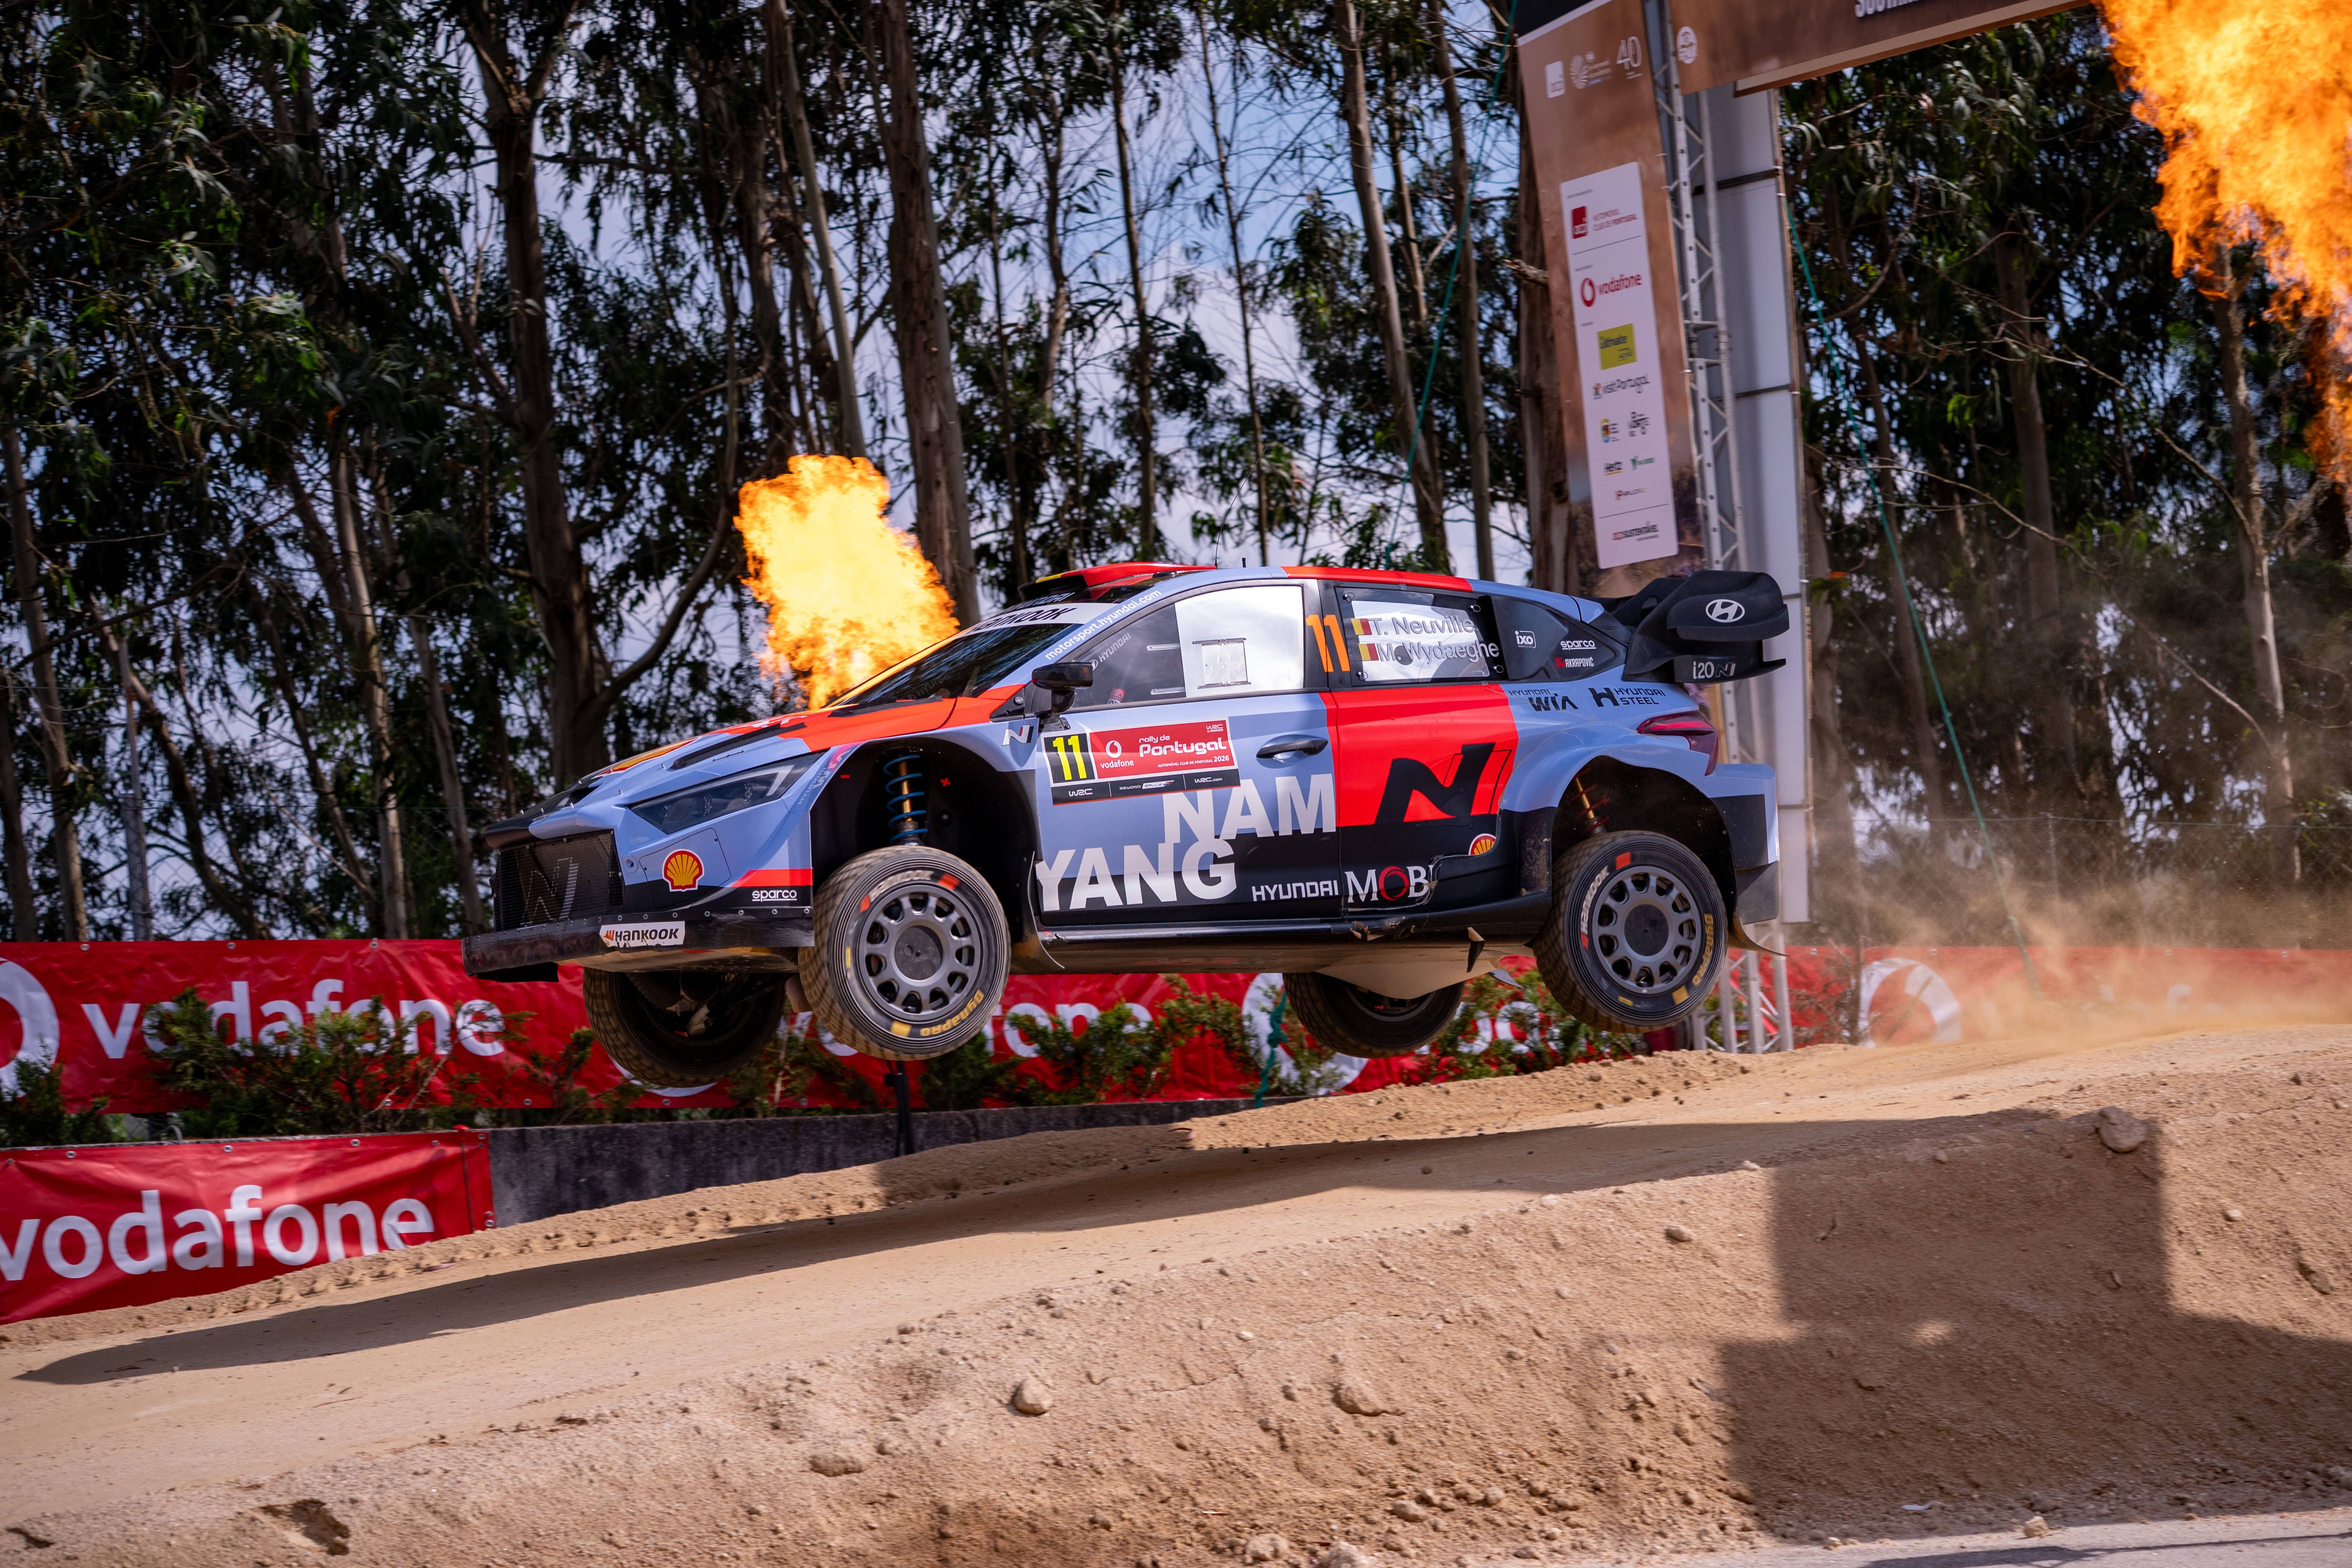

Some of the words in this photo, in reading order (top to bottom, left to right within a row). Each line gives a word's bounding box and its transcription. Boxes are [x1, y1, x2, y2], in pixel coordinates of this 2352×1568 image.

[1616, 36, 1642, 70] 40
[1597, 274, 1642, 296] vodafone
[1045, 590, 1162, 660] motorsport.hyundai.com
[1368, 618, 1388, 635] T.
[1393, 615, 1475, 634] Neuville
[1098, 632, 1131, 663] HYUNDAI
[1305, 615, 1350, 672] 11
[1515, 630, 1534, 645] ixo
[1561, 640, 1596, 650] sparco
[1377, 644, 1401, 662] M.
[1405, 639, 1500, 664] Wydaeghe
[1693, 661, 1714, 680] i20
[1614, 688, 1666, 696] HYUNDAI
[1620, 697, 1659, 705] STEEL
[1053, 735, 1087, 780] 11
[1139, 737, 1227, 758] Portugal
[1100, 760, 1134, 769] vodafone
[1068, 788, 1093, 797] WRC
[1163, 774, 1336, 844] NAM
[1036, 838, 1237, 912] YANG
[752, 890, 797, 902] sparco
[1251, 880, 1339, 902] HYUNDAI
[0, 1184, 434, 1281] vodafone
